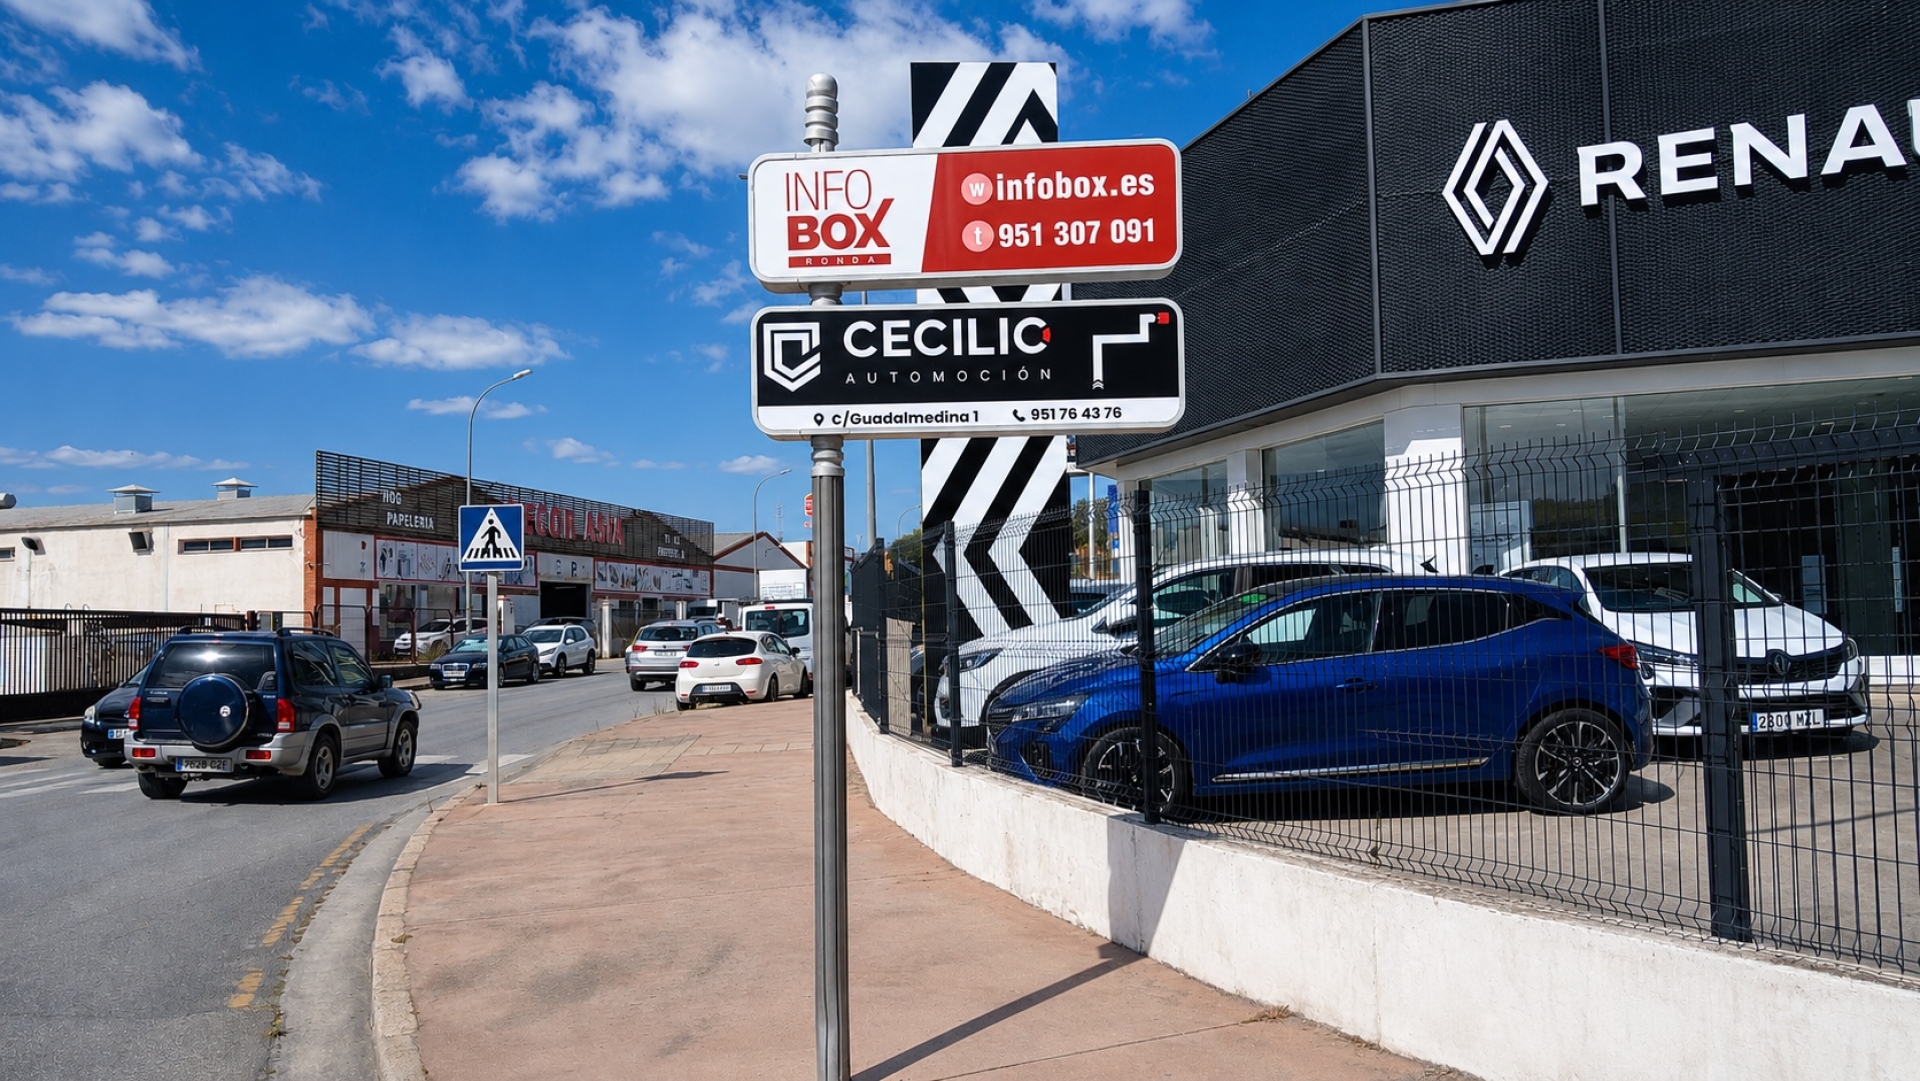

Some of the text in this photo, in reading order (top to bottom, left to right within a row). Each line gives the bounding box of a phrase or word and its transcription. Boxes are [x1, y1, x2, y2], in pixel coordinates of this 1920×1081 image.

[786, 169, 872, 212] INFO
[996, 171, 1155, 201] infobox.es
[787, 198, 895, 251] BOX
[999, 222, 1042, 248] 951
[1053, 220, 1101, 246] 307
[1110, 217, 1155, 245] 091
[805, 256, 876, 266] RONDA
[845, 366, 1051, 385] AUTOMOCIÓN
[831, 410, 979, 427] c/Guadalmedina 1
[1031, 406, 1122, 420] 951 76 43 76
